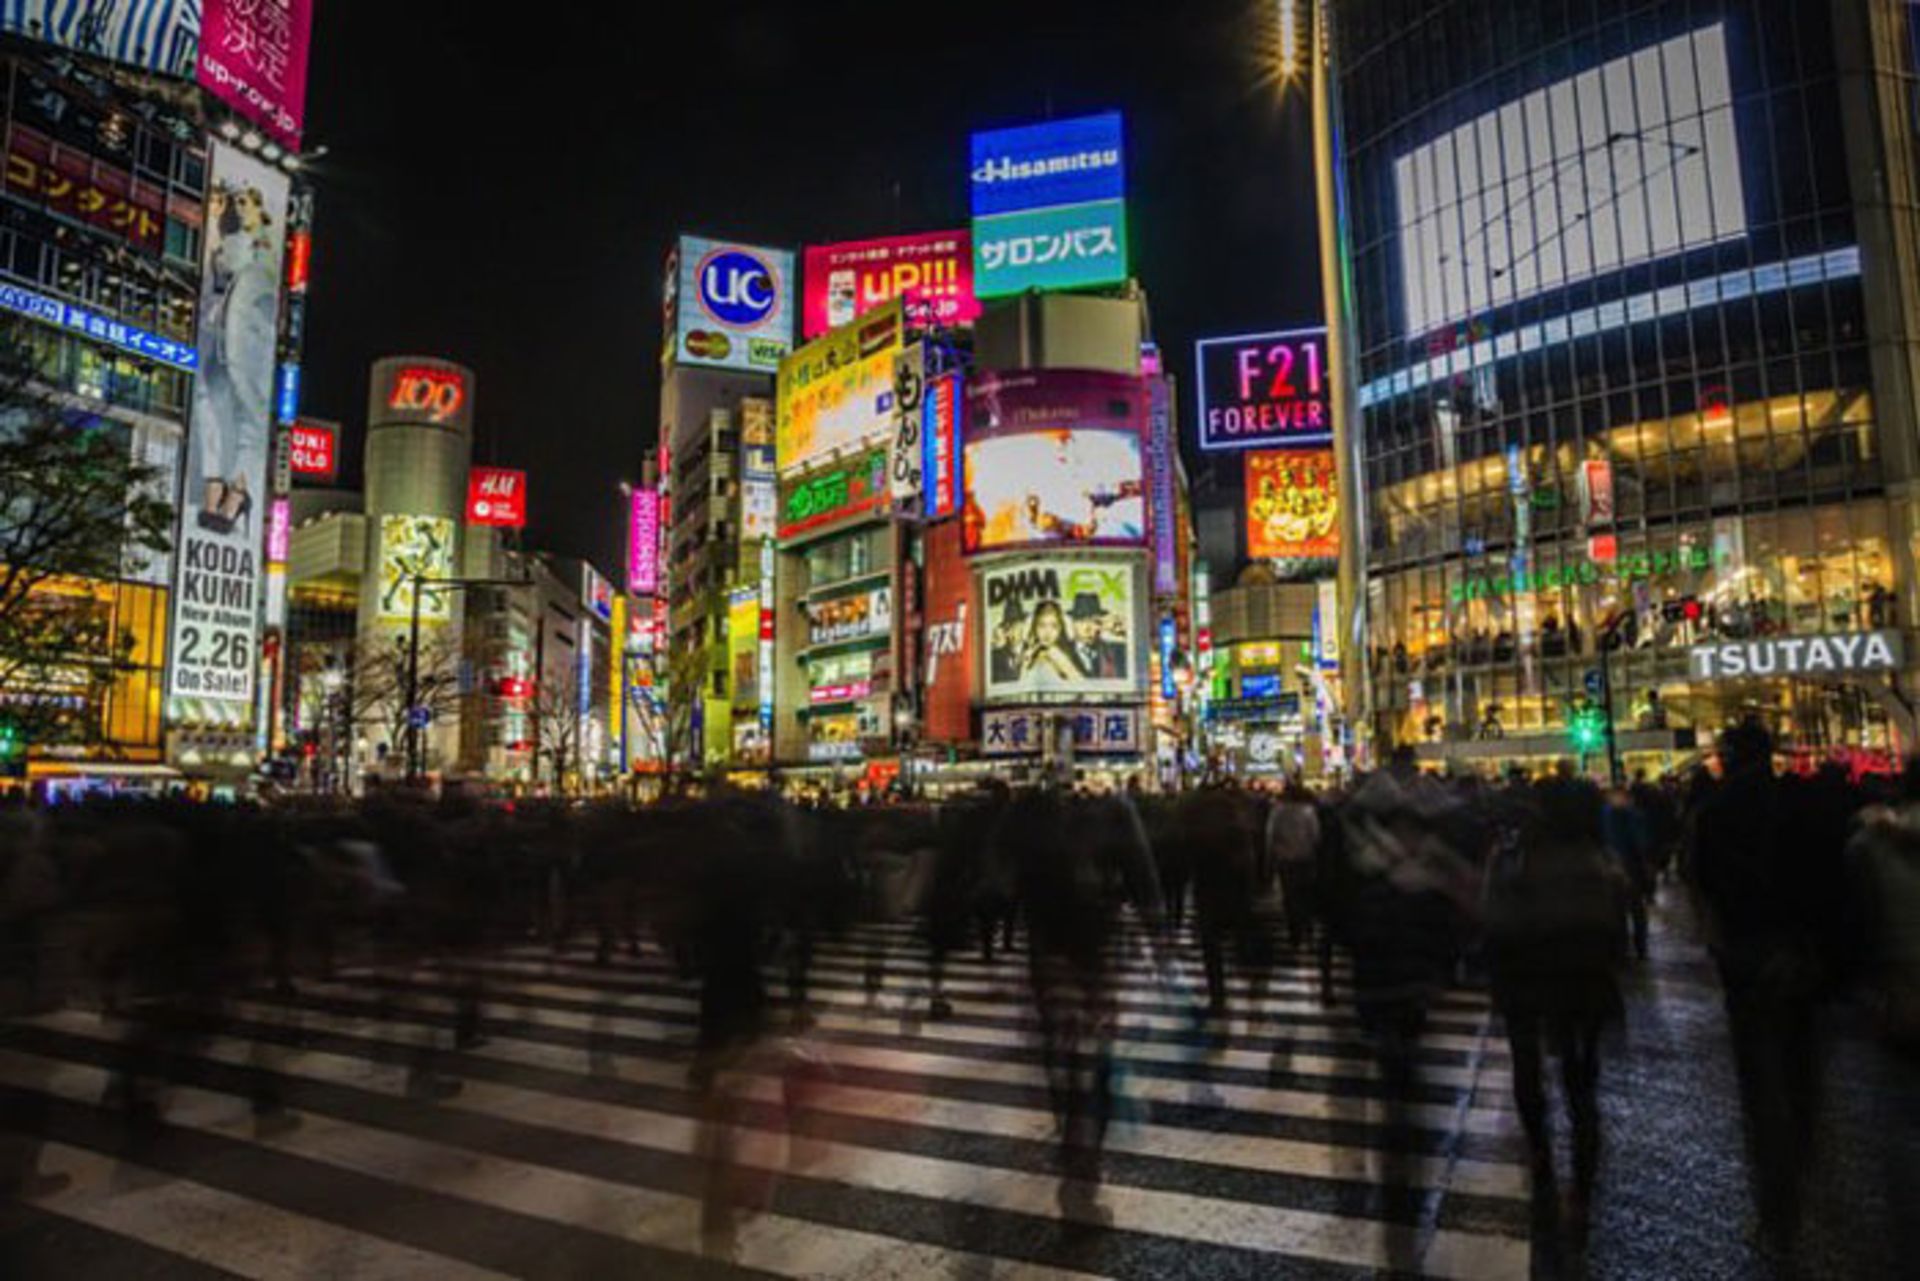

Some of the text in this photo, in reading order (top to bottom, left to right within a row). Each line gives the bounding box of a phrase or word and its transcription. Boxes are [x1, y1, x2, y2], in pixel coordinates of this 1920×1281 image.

[972, 150, 1118, 183] Hisamitsu
[7, 154, 159, 237] コンタクト
[980, 225, 1118, 270] サロンパス
[706, 265, 773, 310] UC
[1238, 342, 1321, 401] F21
[390, 370, 465, 421] 109
[1208, 400, 1324, 436] FOREVER
[291, 430, 326, 451] UNI
[291, 449, 328, 469] QLO
[185, 538, 255, 579] KODA
[183, 570, 252, 612] KUMI
[986, 568, 1126, 608] DMM FX
[180, 604, 252, 628] New Album
[179, 626, 249, 672] 2.26
[1693, 633, 1894, 677] TSUTAYA
[176, 668, 248, 694] On Sale!
